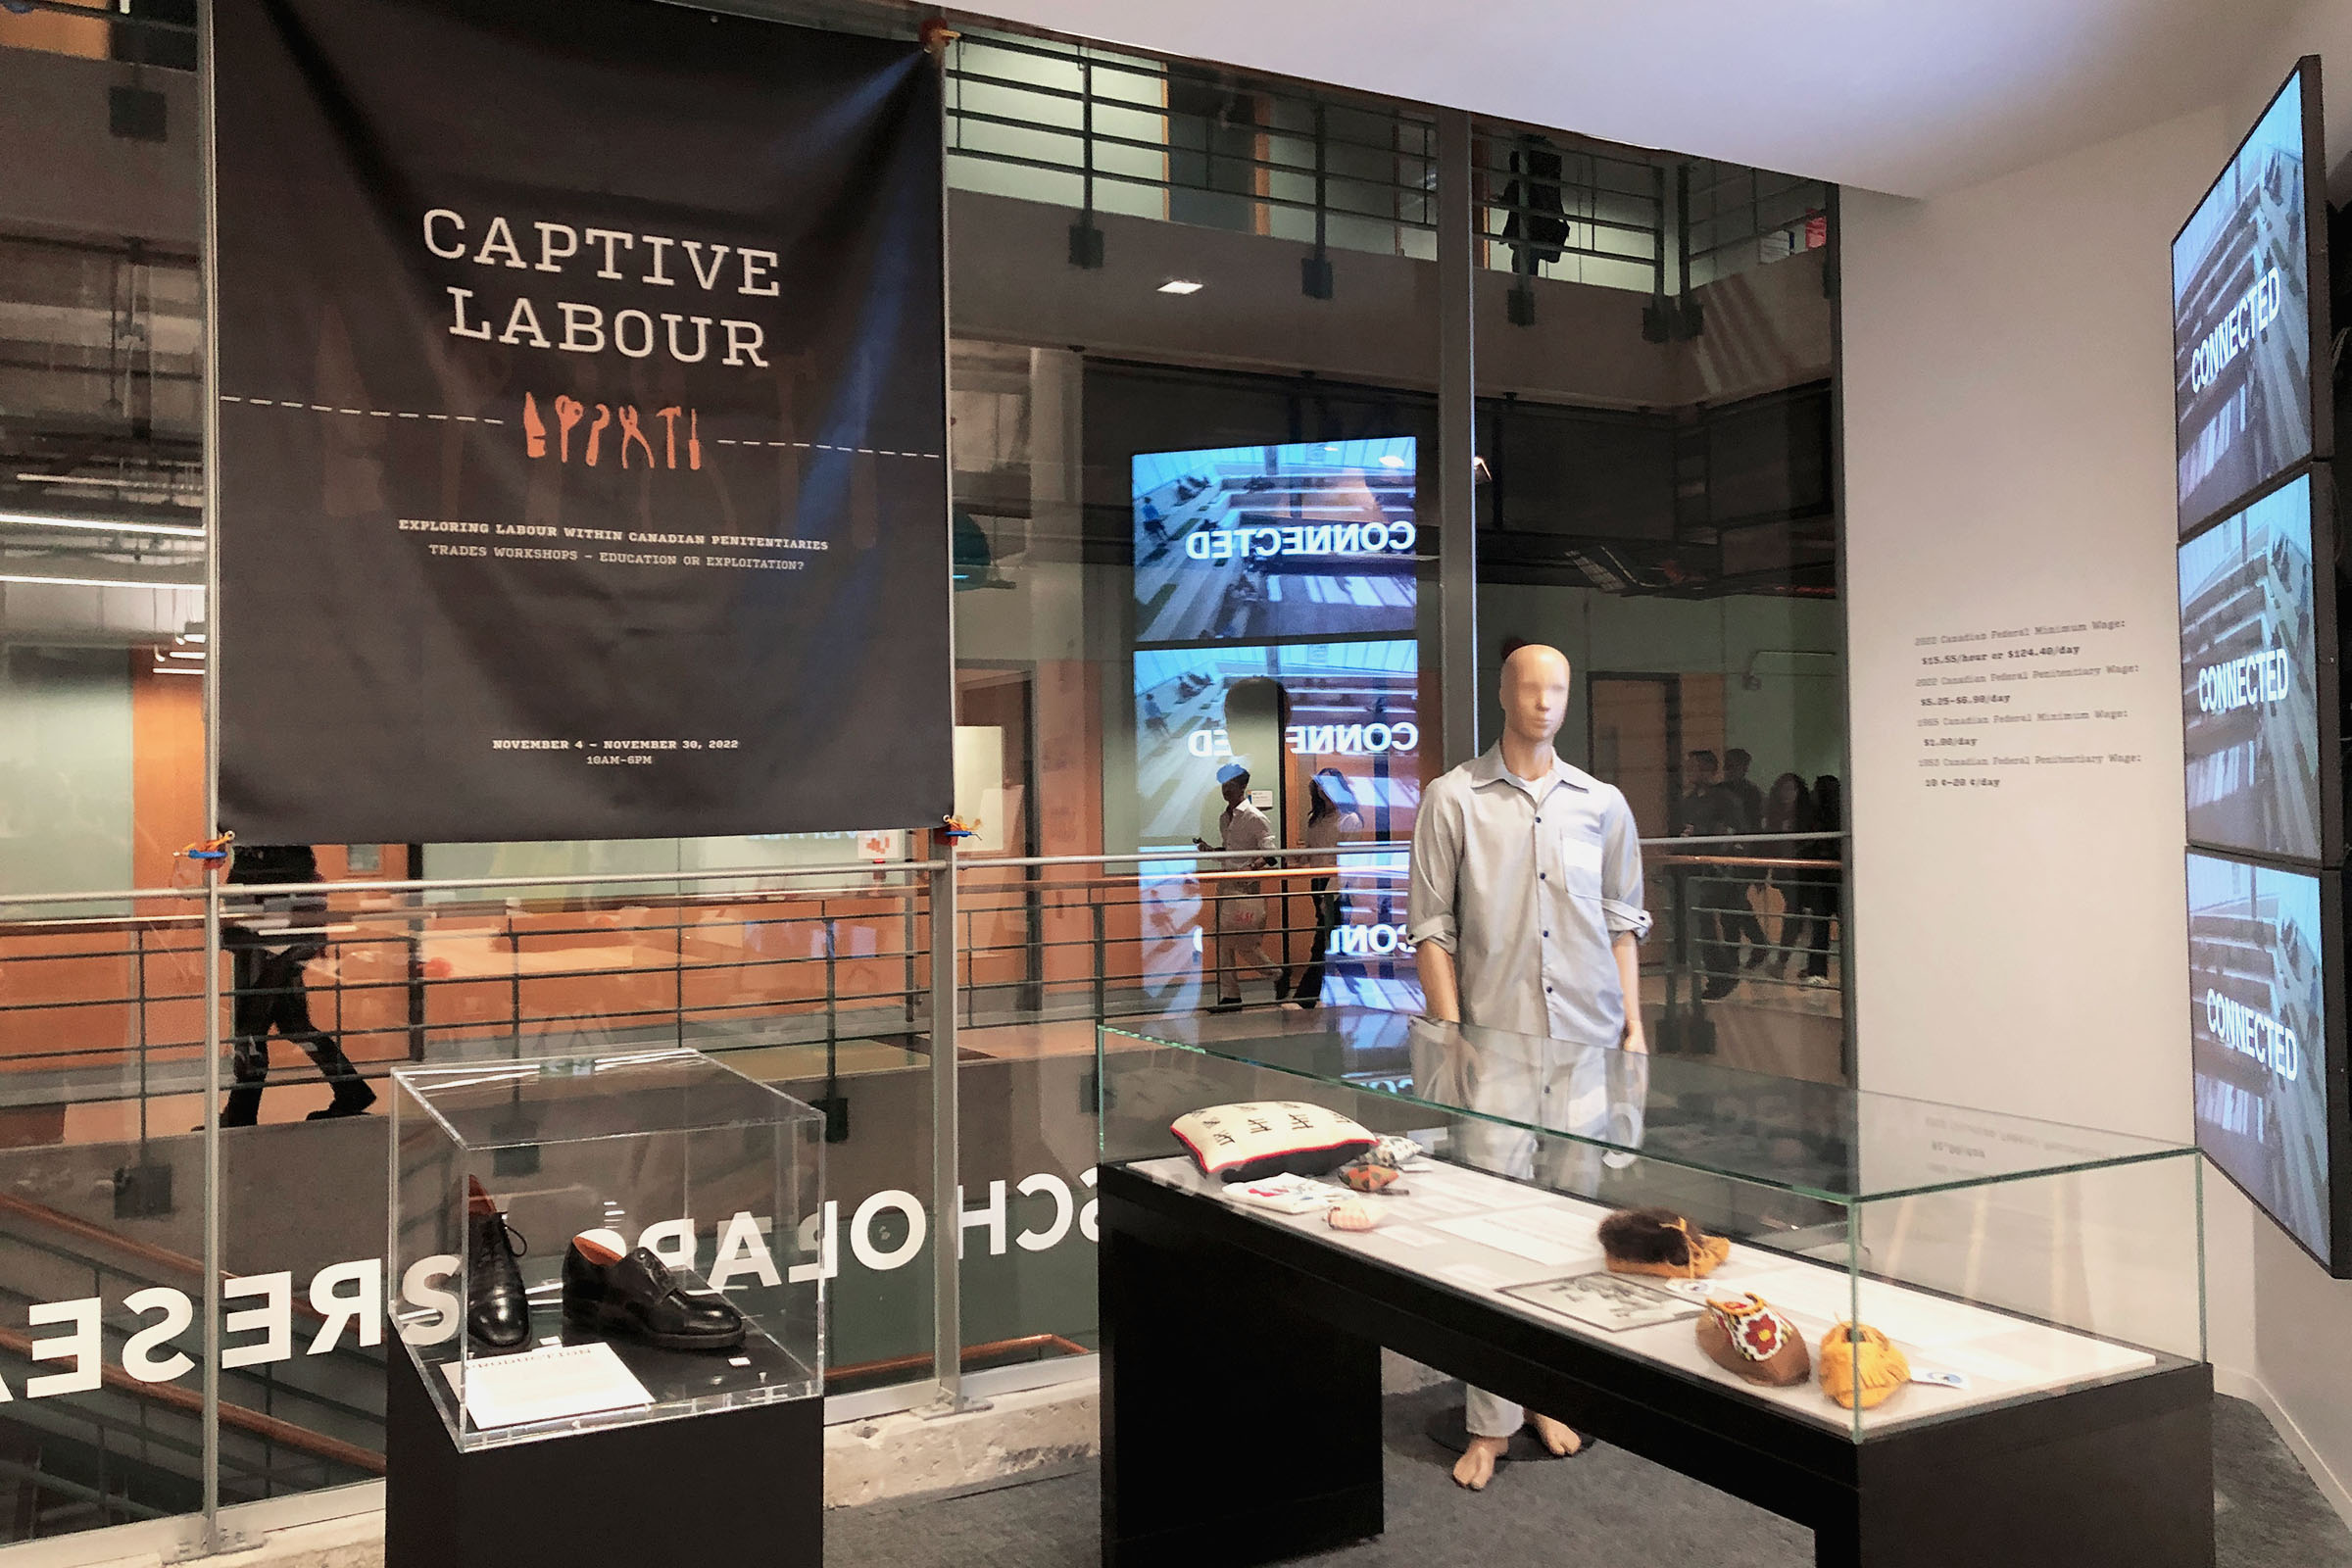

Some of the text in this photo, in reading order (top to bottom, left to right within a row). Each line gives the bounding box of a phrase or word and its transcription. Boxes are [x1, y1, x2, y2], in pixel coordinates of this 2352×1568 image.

[423, 209, 780, 297] CAPTIVE
[447, 286, 769, 368] LABOUR
[2190, 267, 2281, 394] CONNECTED
[398, 519, 829, 551] EXPLORING LABOUR WITHIN CANADIAN PENITENTIARIES
[428, 544, 488, 557] TRADES
[494, 547, 578, 561] WORKSHOPS
[600, 552, 677, 565] EDUCATION
[683, 556, 701, 565] OR
[707, 557, 805, 570] EXPLOITATION?
[1940, 633, 1987, 644] Canadian
[1991, 627, 2030, 639] Federal
[2034, 623, 2087, 635] Minimum
[2091, 620, 2126, 630] Wage:
[1940, 675, 1986, 685] Canadian
[1990, 671, 2029, 681] Federal
[2033, 667, 2102, 679] Penitentiary
[2106, 664, 2139, 674] Wage:
[2198, 647, 2289, 712] CONNECTED
[1942, 716, 1989, 726] Canadian
[1993, 713, 2033, 723] Federal
[2036, 711, 2089, 722] Minimum
[2094, 710, 2129, 719] Wage:
[492, 740, 569, 750] NOVEMBER
[574, 740, 583, 750] 4
[604, 740, 677, 750] NOVEMBER
[682, 740, 703, 751] 30,
[709, 739, 739, 750] 2022
[586, 755, 653, 765] 10AM-6PM
[1942, 758, 1989, 766] Canadian
[1992, 756, 2031, 765] Federal
[2034, 755, 2104, 764] Penitentiary
[2108, 753, 2141, 763] Wage:
[2206, 987, 2299, 1082] CONNECTED
